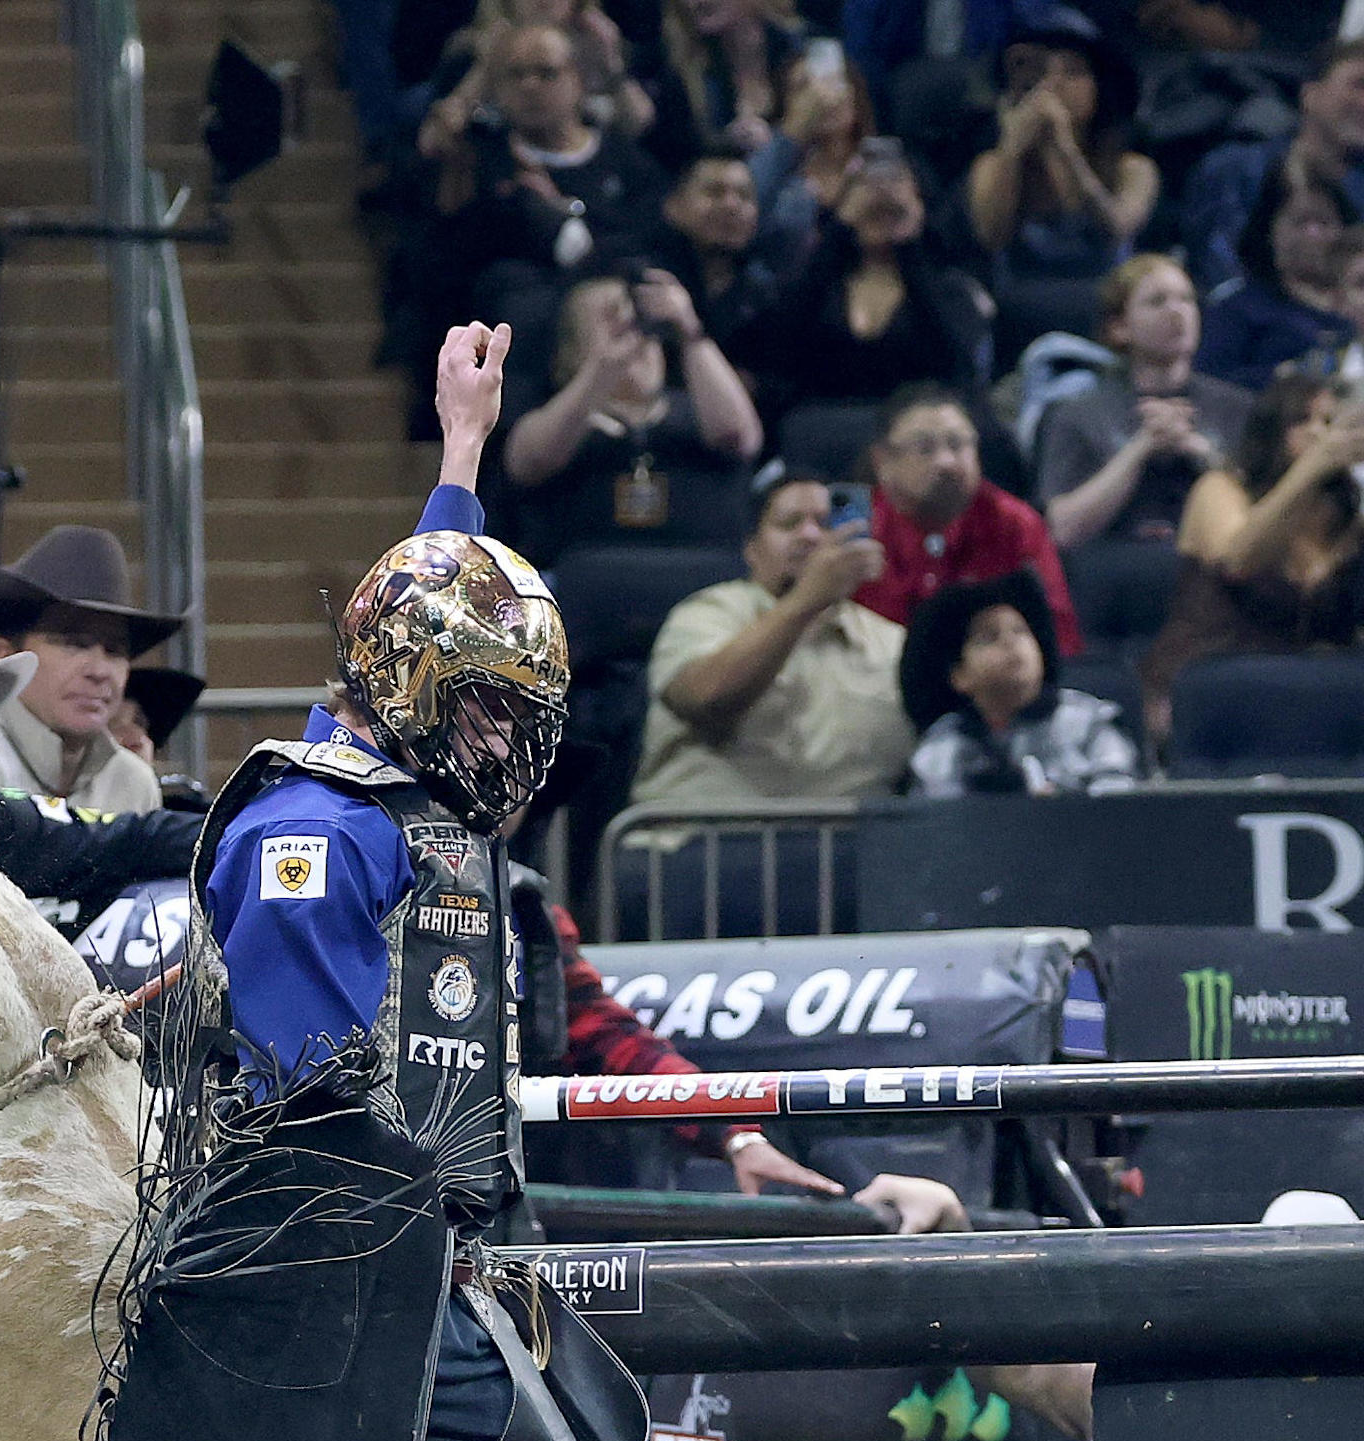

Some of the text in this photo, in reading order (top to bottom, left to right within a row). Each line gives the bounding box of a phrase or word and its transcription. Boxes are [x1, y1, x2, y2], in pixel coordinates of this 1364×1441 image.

[265, 843, 324, 855] ARIAT
[438, 893, 479, 911] TEXAS
[417, 906, 490, 938] RATTLERS
[602, 970, 778, 1041] CAS
[407, 1033, 486, 1071] RTIC
[574, 1074, 769, 1104] LUCAS OIL
